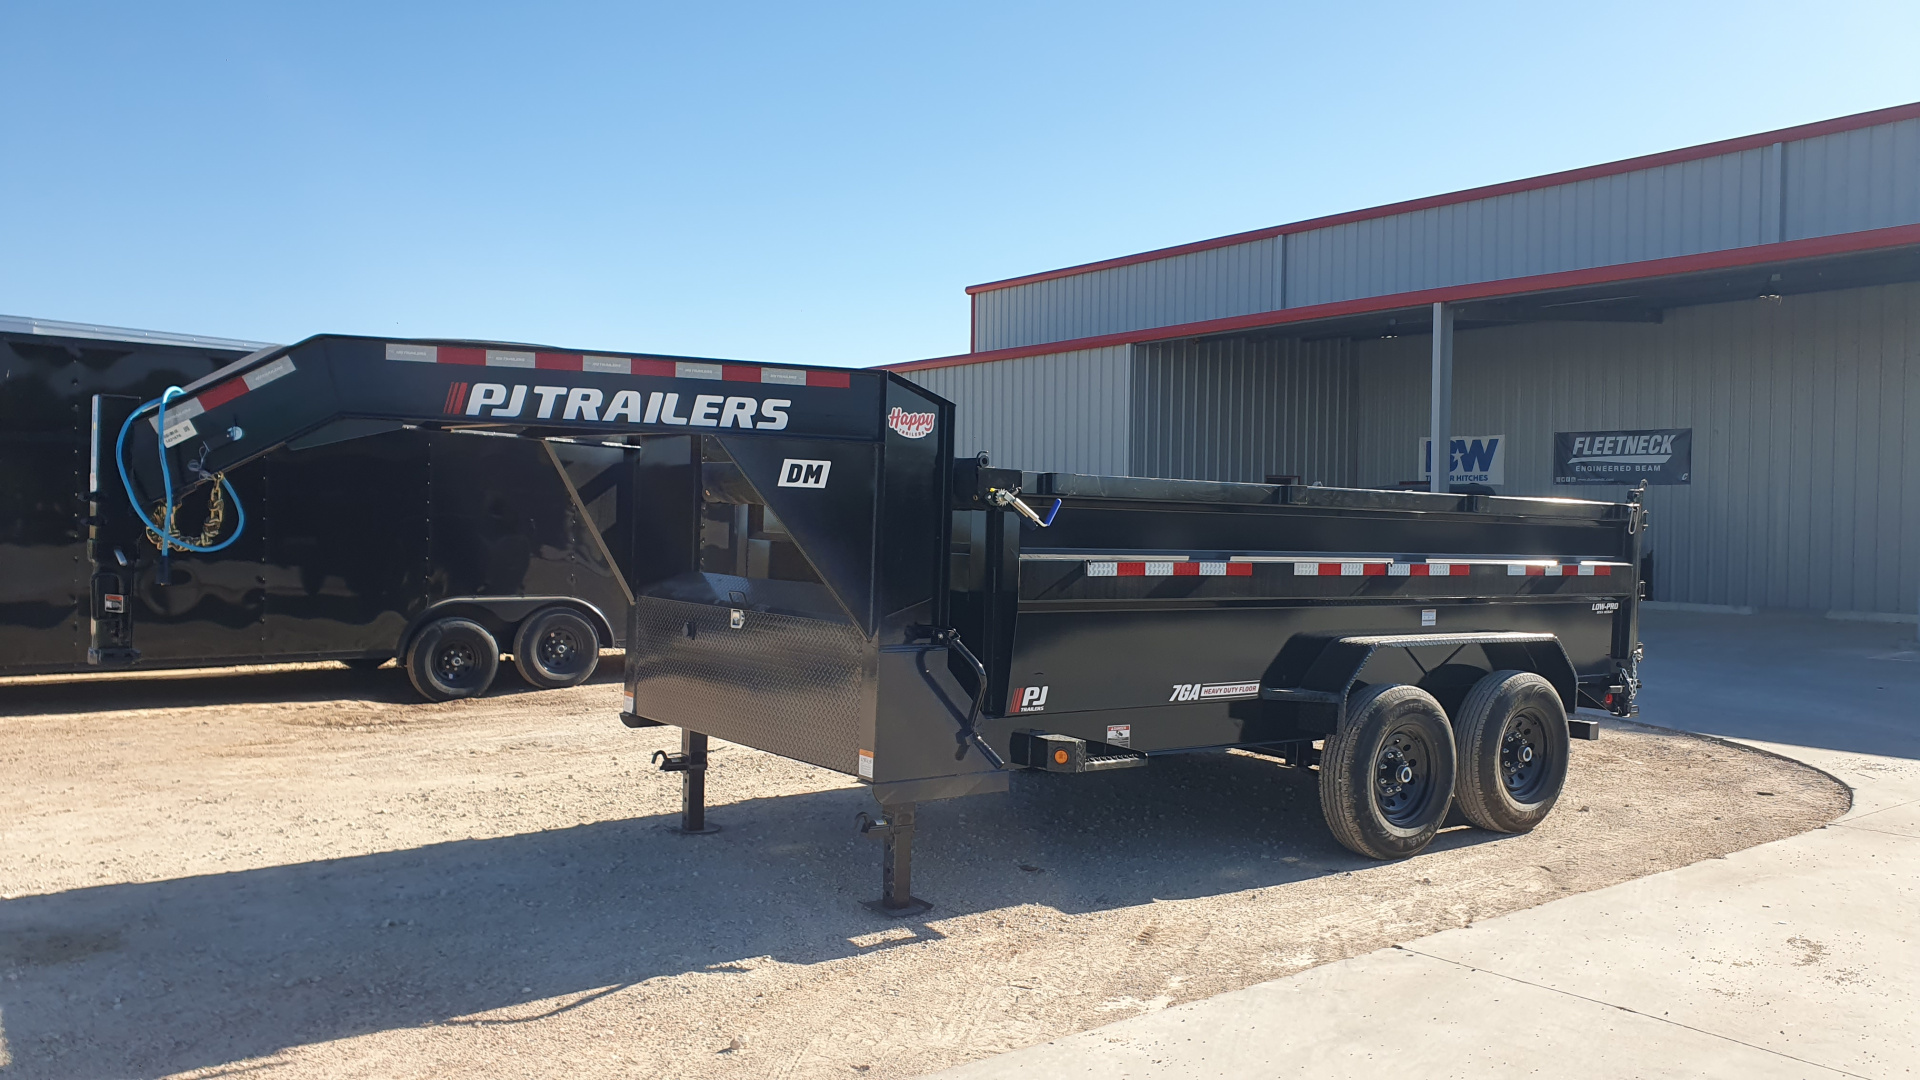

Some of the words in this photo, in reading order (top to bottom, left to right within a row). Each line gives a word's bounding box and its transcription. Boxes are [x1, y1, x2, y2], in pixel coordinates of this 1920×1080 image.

[465, 382, 528, 417] PJ
[533, 385, 792, 431] TRAILERS
[889, 408, 934, 432] Happy
[1572, 434, 1677, 455] FLEETNECK
[786, 463, 824, 485] DM
[1456, 474, 1489, 482] HITCHES
[1591, 602, 1619, 611] LOW-PRO
[1021, 685, 1049, 706] PJ
[1169, 683, 1201, 701] 7GA
